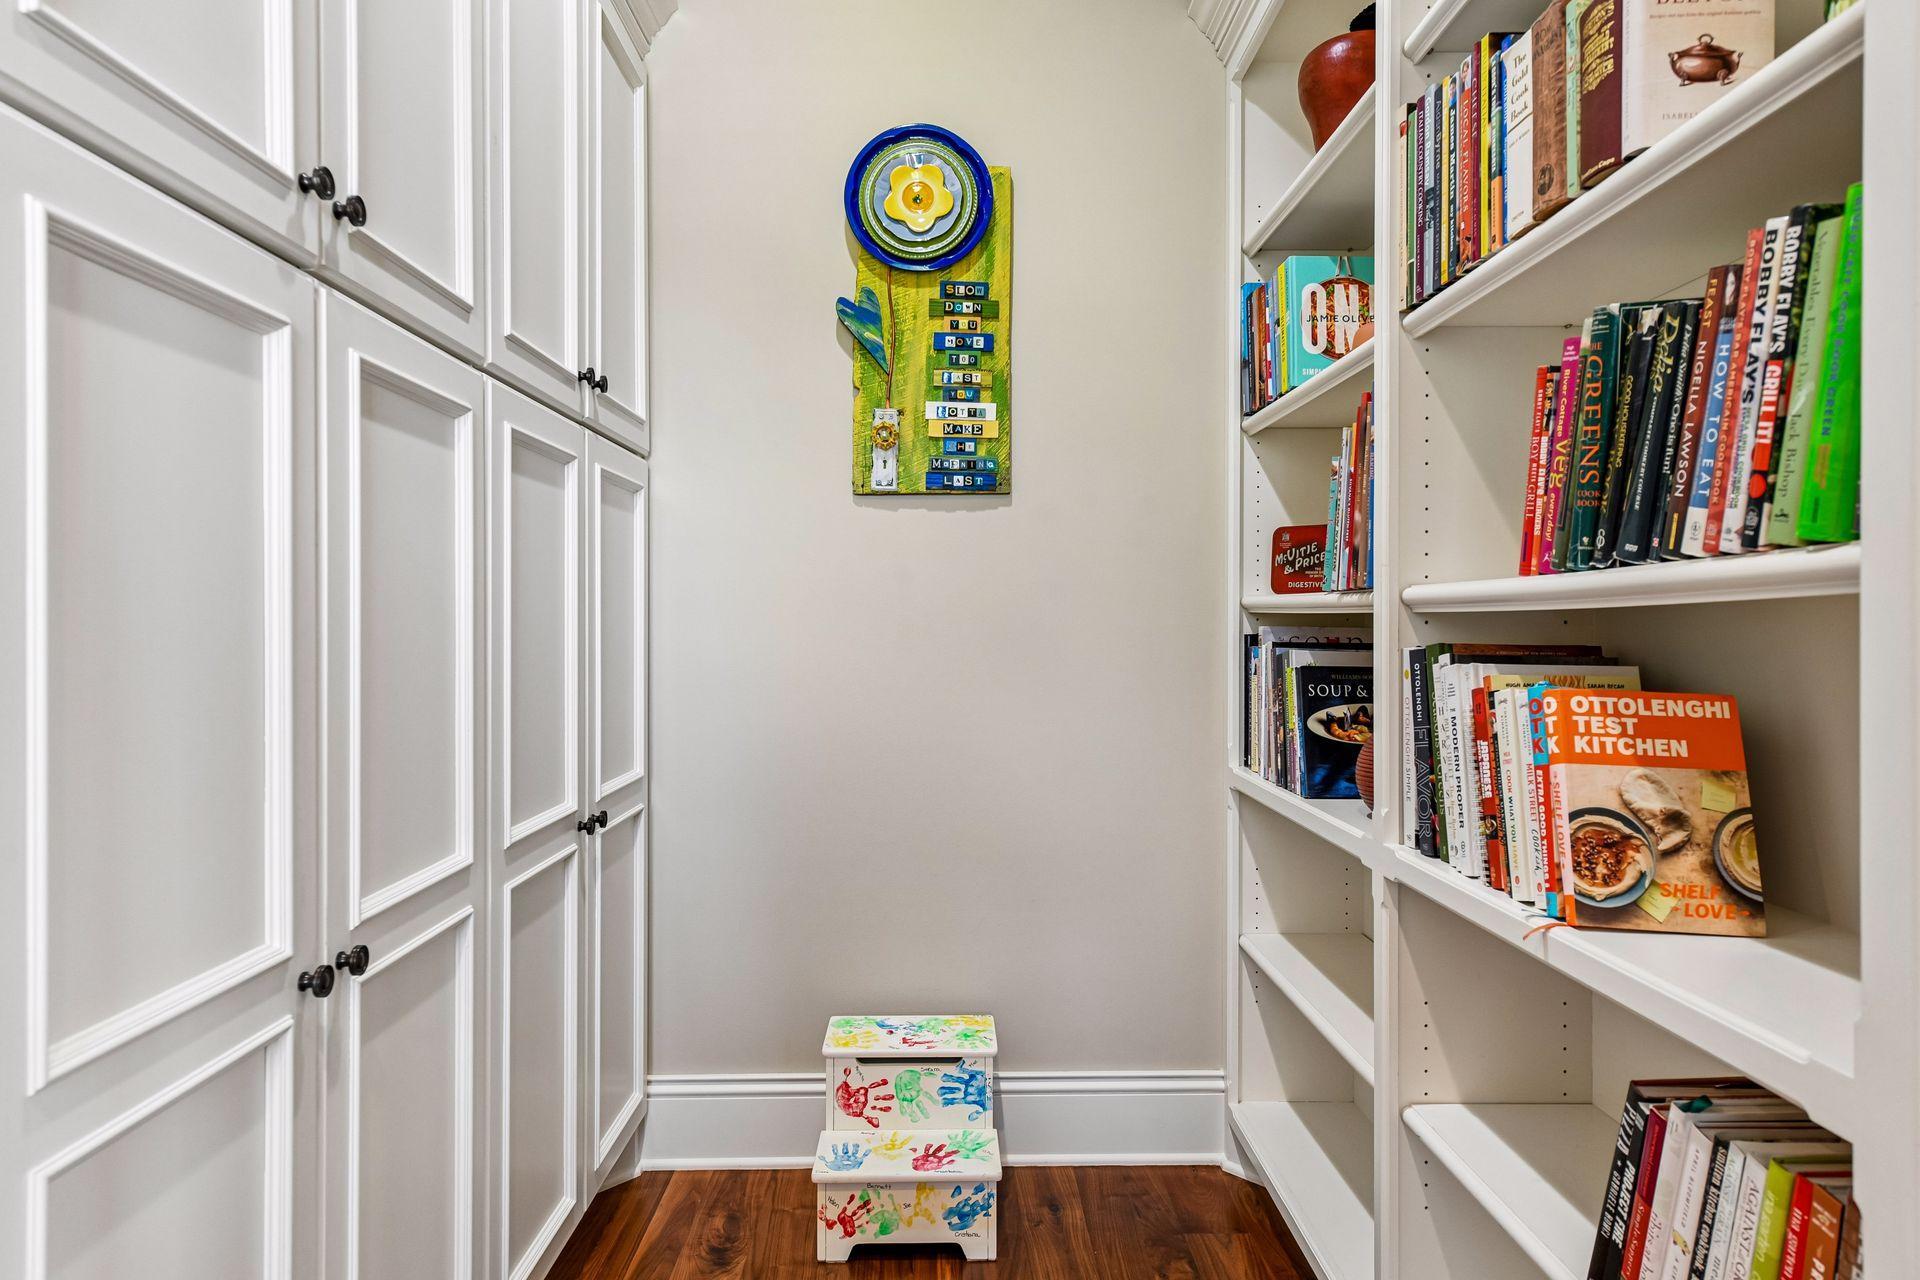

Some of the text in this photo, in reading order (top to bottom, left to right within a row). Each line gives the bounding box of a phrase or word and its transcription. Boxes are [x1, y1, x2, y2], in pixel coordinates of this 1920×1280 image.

[1461, 99, 1470, 146] LOCAL
[1461, 150, 1470, 212] FLAVORS
[1742, 239, 1756, 290] BOBBY
[945, 302, 982, 312] DOWN
[946, 285, 984, 296] SLOW
[1700, 278, 1719, 328] FEAST
[1768, 224, 1802, 355] BOBBY FLAY'S
[952, 321, 976, 329] YOU
[1302, 283, 1374, 354] ON
[1306, 315, 1374, 323] JAMIE OLIVE
[1734, 293, 1748, 329] FLAY'S
[1741, 228, 1778, 404] BOBBY FLAY'S
[946, 336, 982, 346] MOVE
[952, 354, 974, 362] TOO
[1652, 316, 1680, 392] Delia
[1680, 324, 1693, 358] Delia
[1730, 334, 1742, 360] BAR
[944, 374, 979, 384] FAST
[1562, 368, 1571, 396] River
[1712, 344, 1731, 399] HOW
[938, 407, 986, 417] GOTTA
[1720, 362, 1738, 430] AMERICAIN
[1756, 365, 1782, 445] GRILL IT!
[1820, 386, 1839, 436] GREEN
[944, 424, 982, 434] MAKE
[1556, 397, 1568, 437] Cottage
[1579, 355, 1603, 484] GREENS
[1614, 376, 1634, 468] GOOD HOUSEKEEPING
[1674, 341, 1708, 498] NIGELLA LAWSON
[1706, 416, 1720, 442] TO
[932, 459, 994, 468] MORNING
[1530, 436, 1540, 461] BOY
[1549, 439, 1568, 488] veg
[1634, 396, 1658, 511] COMPLETE COOKERY COURSE
[1662, 446, 1676, 474] fun!
[944, 476, 982, 486] LAST
[1530, 463, 1538, 482] MEETS
[1697, 458, 1716, 497] EAT
[1712, 434, 1728, 505] COOKBOOK
[1732, 461, 1746, 509] COOKBOOK
[1776, 448, 1798, 498] Bishop
[1525, 484, 1536, 520] GRILL
[1534, 498, 1544, 536] BURGERS
[1295, 552, 1326, 570] PRICE
[1308, 684, 1368, 697] SOUP &
[1414, 663, 1422, 722] OTTOLENGHI
[1529, 698, 1543, 714] O
[1543, 696, 1558, 714] O
[1570, 696, 1730, 720] OTTOLENGHI
[1532, 718, 1542, 734] T
[1545, 716, 1557, 734] T
[1572, 716, 1638, 735] TEST
[1533, 738, 1544, 754] K
[1547, 736, 1560, 754] K
[1573, 736, 1688, 758] KITCHEN
[1414, 728, 1432, 838] FLAVOR
[1450, 716, 1465, 829] MODERN PROPER
[1480, 740, 1492, 798] JAPANESE
[1526, 762, 1537, 788] MILK
[1528, 789, 1538, 823] STREET
[1536, 770, 1550, 880] EXTRA GOOD THINGS
[1553, 782, 1567, 858] SHELF LOVE
[1660, 882, 1722, 900] SHELF
[1684, 902, 1737, 920] LOVE
[1617, 1102, 1636, 1156] PIZZA
[1710, 1146, 1728, 1186] smitten
[1612, 1160, 1636, 1250] PROJECT FIRE
[1680, 1148, 1700, 1228] APRIL BLOOMFIELD
[1702, 1186, 1721, 1226] kitchen
[1740, 1180, 1759, 1256] AGAINST
[1756, 1190, 1775, 1262] ina garten
[1624, 1204, 1645, 1277] Simple Suppers
[1784, 1206, 1808, 1278] ina garten
